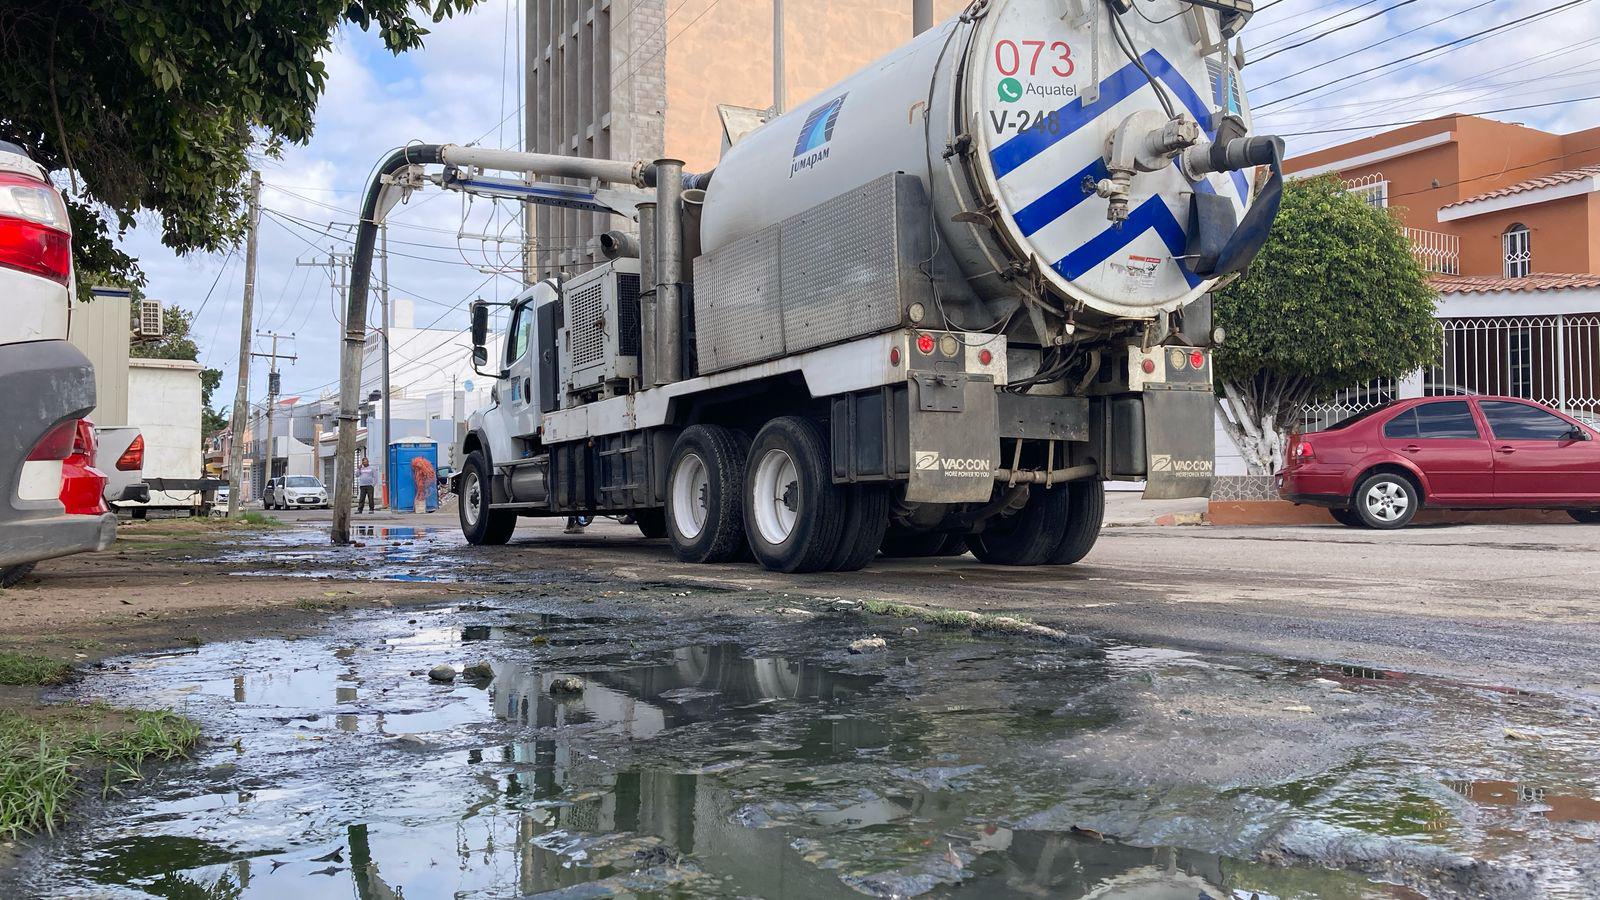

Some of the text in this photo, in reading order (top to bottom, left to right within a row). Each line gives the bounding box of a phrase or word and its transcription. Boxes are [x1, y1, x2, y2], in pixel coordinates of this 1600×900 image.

[995, 39, 1074, 77] 073
[1026, 82, 1077, 98] Aquatel
[989, 110, 1060, 135] V-248
